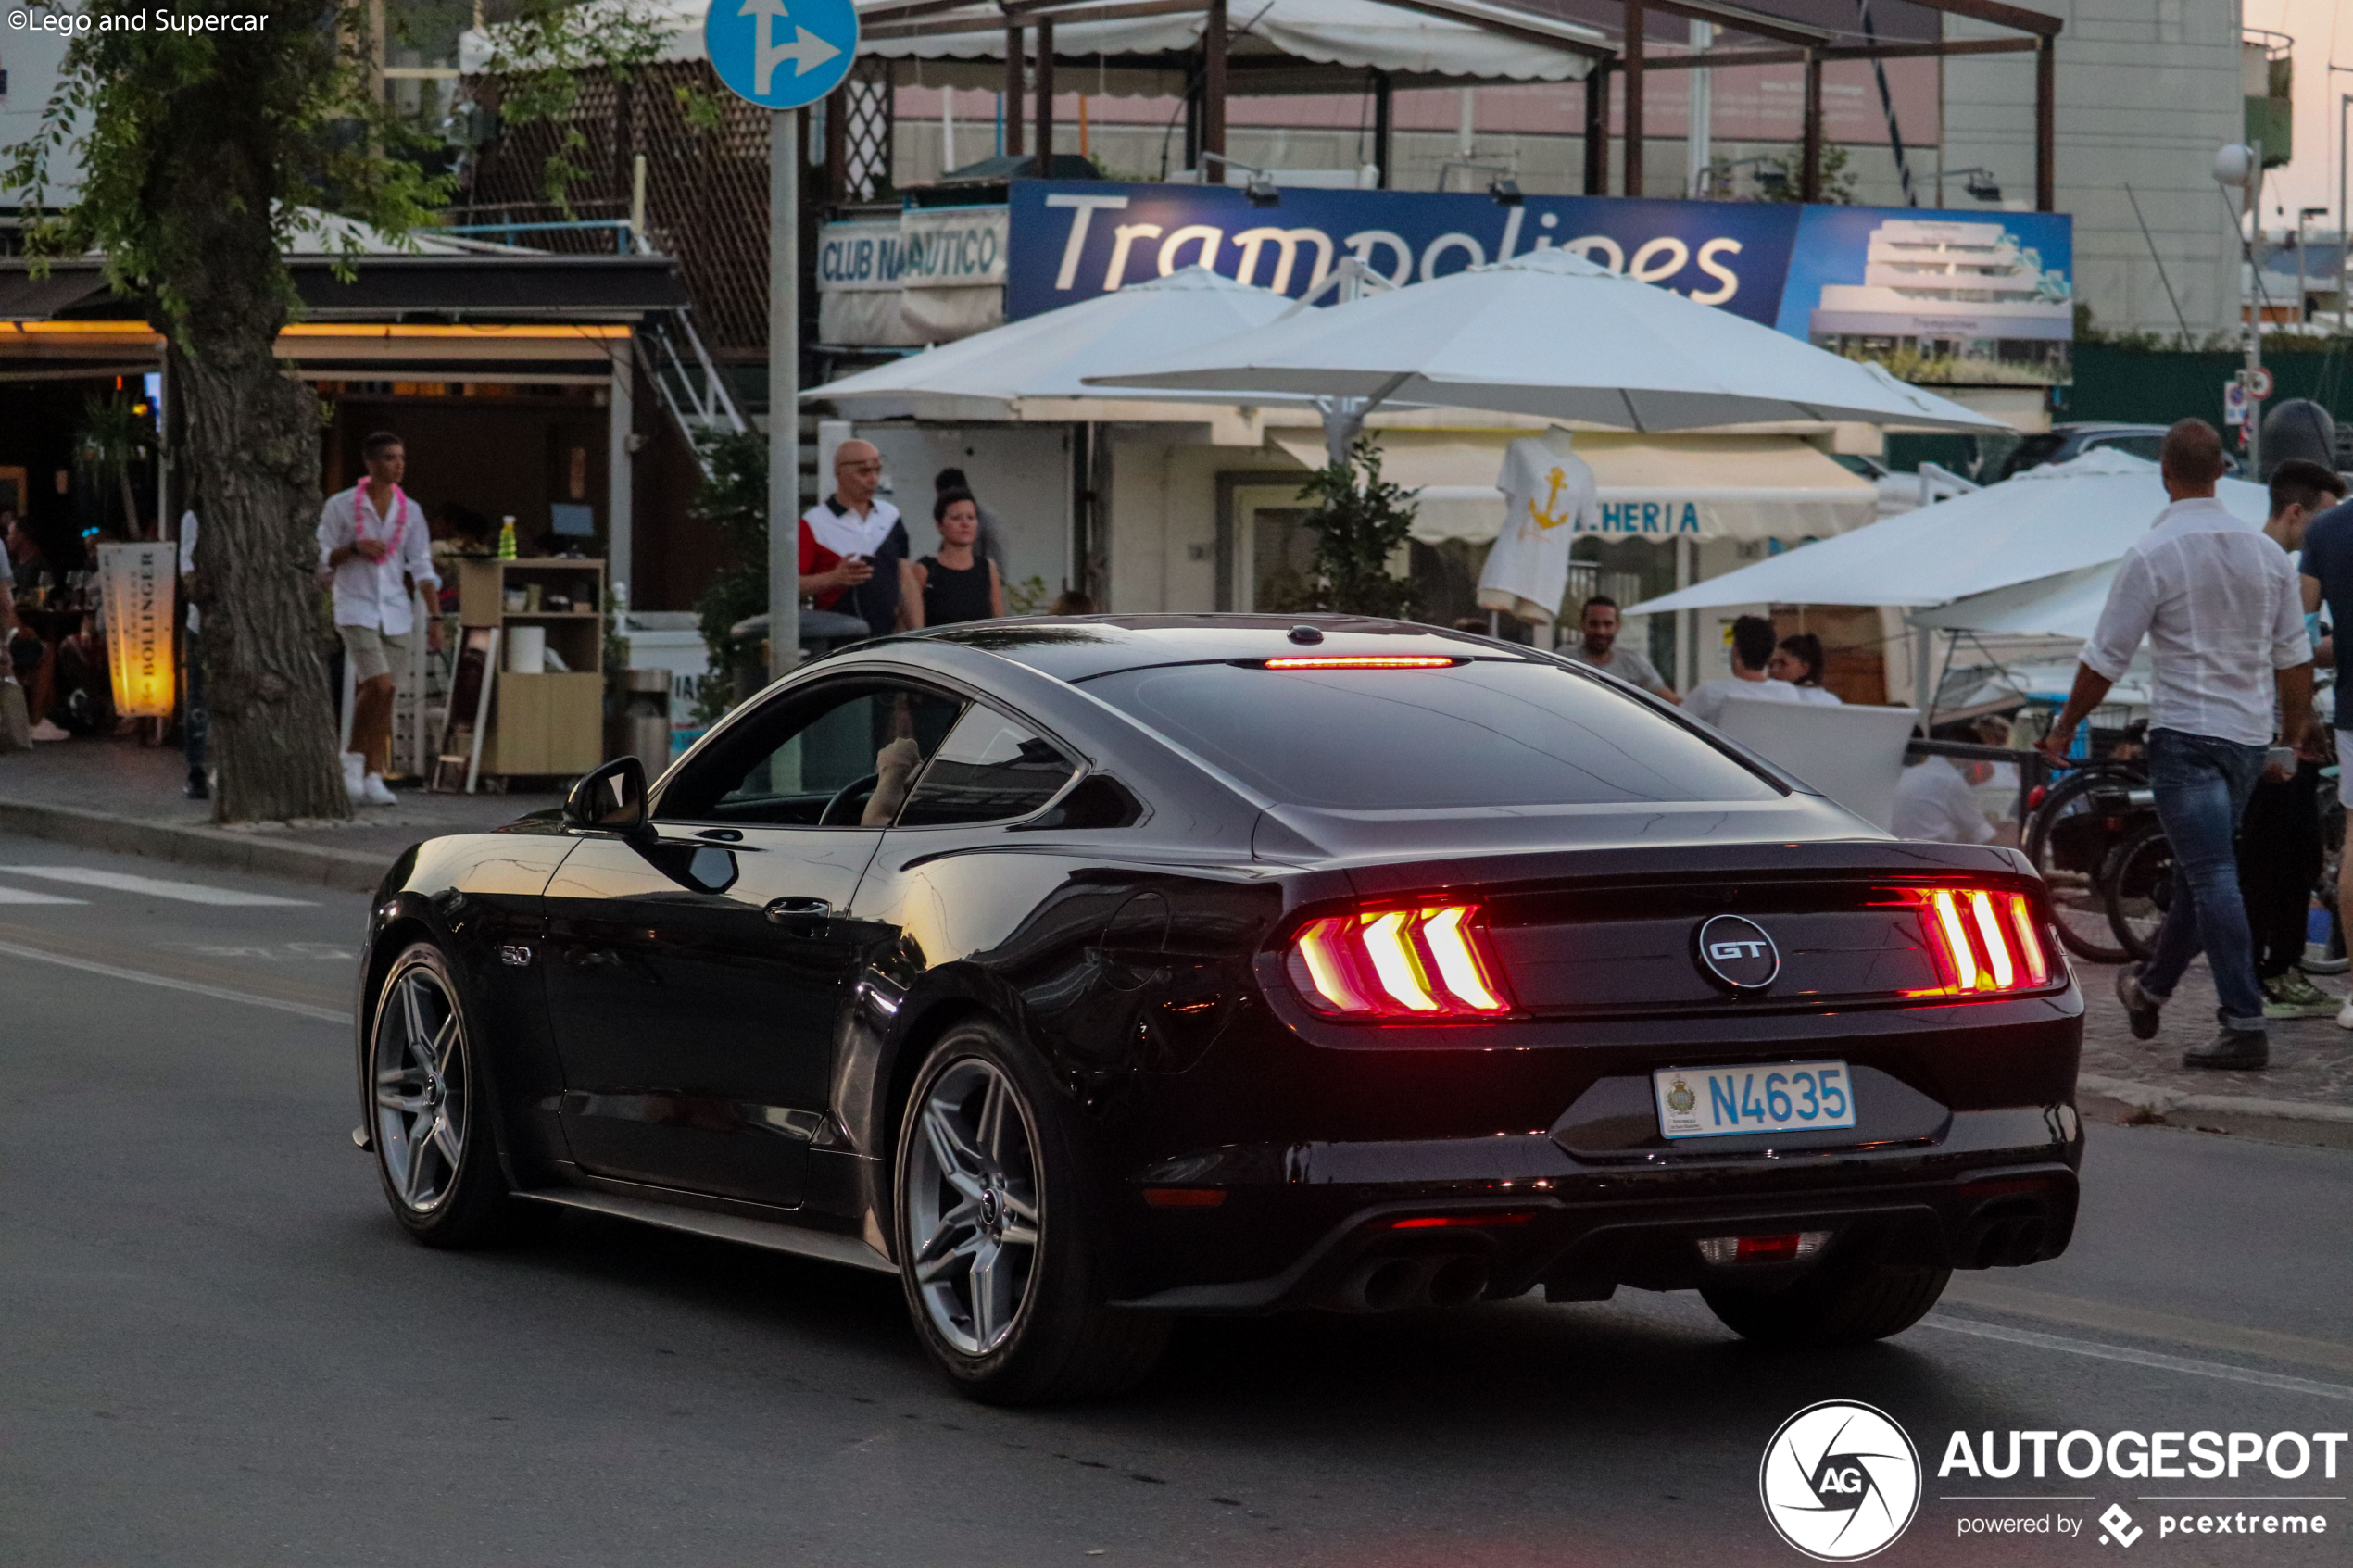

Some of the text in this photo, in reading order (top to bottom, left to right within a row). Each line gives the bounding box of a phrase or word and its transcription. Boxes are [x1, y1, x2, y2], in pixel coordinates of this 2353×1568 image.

[823, 239, 873, 282] CLUB
[1045, 193, 1743, 306] Trampolines
[141, 553, 155, 676] BOLLINGER
[1709, 941, 1767, 960] GT
[1708, 1070, 1847, 1125] N4635
